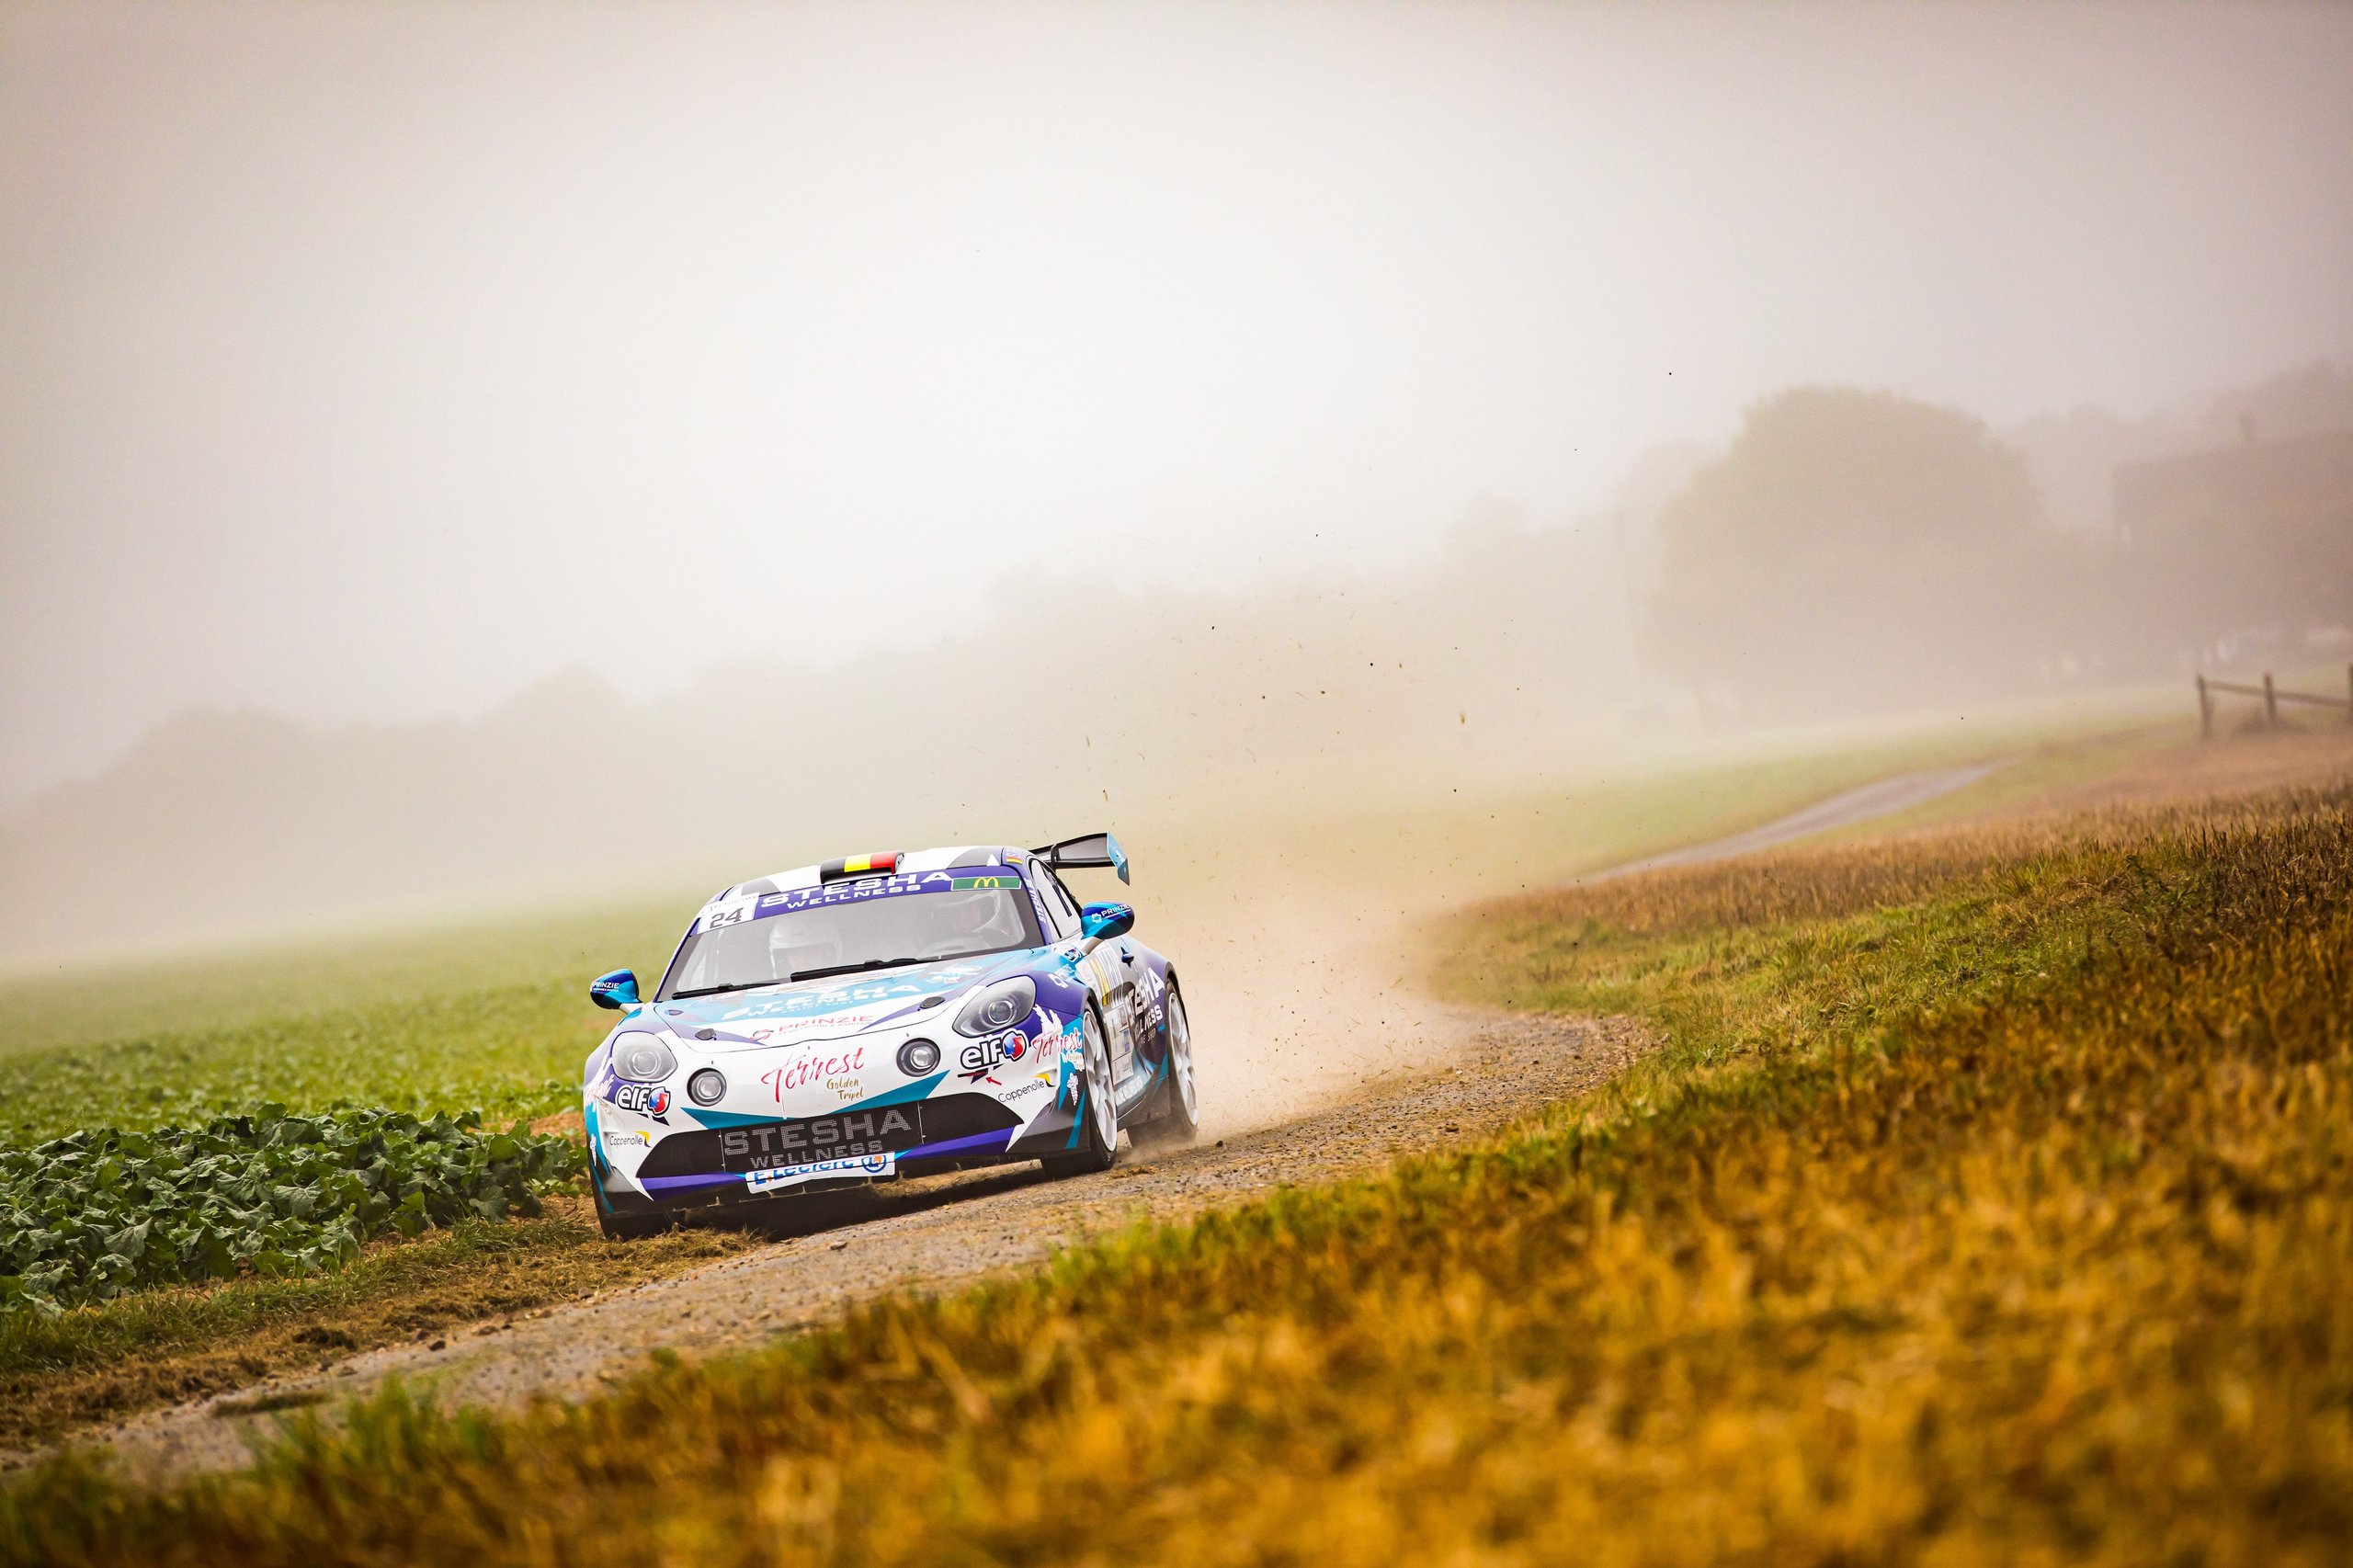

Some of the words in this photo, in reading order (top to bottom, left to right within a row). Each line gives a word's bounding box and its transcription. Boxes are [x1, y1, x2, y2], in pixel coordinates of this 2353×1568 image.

[760, 871, 953, 907] STESHA
[787, 884, 921, 909] WELLNESS
[709, 907, 745, 929] 24
[779, 1016, 873, 1032] PRINZIE
[960, 1037, 1003, 1070] elf
[760, 1047, 864, 1104] Terrest
[826, 1076, 859, 1090] Golden
[617, 1085, 649, 1111] elf
[836, 1087, 864, 1101] Tripel
[997, 1079, 1045, 1103] Coppenolle
[609, 1134, 643, 1148] Coppenolle
[724, 1109, 912, 1156] STESHA
[750, 1140, 883, 1169] WELLNESS
